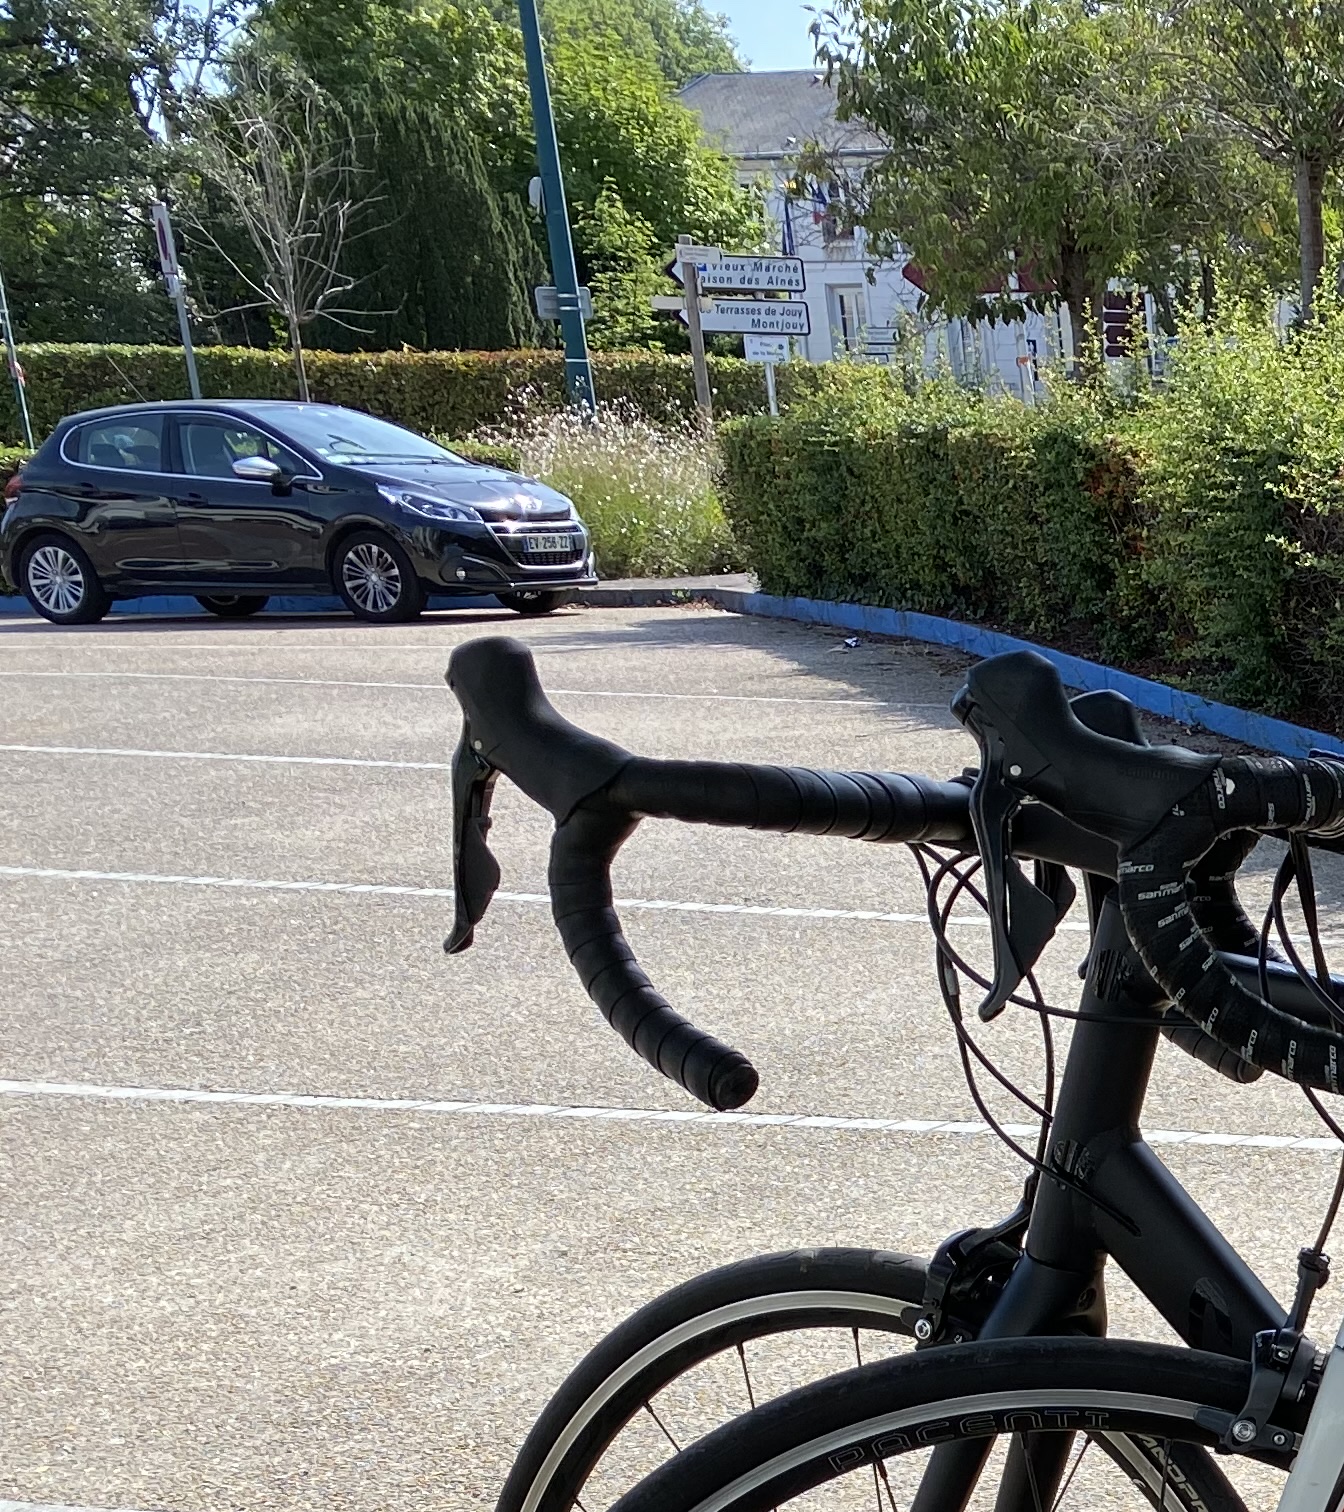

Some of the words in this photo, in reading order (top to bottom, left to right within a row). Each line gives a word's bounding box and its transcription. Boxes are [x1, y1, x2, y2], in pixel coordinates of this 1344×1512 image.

[752, 262, 799, 273] Marché
[701, 275, 733, 284] aison
[740, 275, 760, 285] des
[715, 303, 761, 315] Terrasses
[764, 305, 776, 316] de
[779, 306, 803, 318] Jouy
[751, 318, 805, 331] Montjouy
[1211, 767, 1226, 809] marco
[1118, 863, 1155, 875] marco
[828, 1410, 1110, 1474] PACENTI
